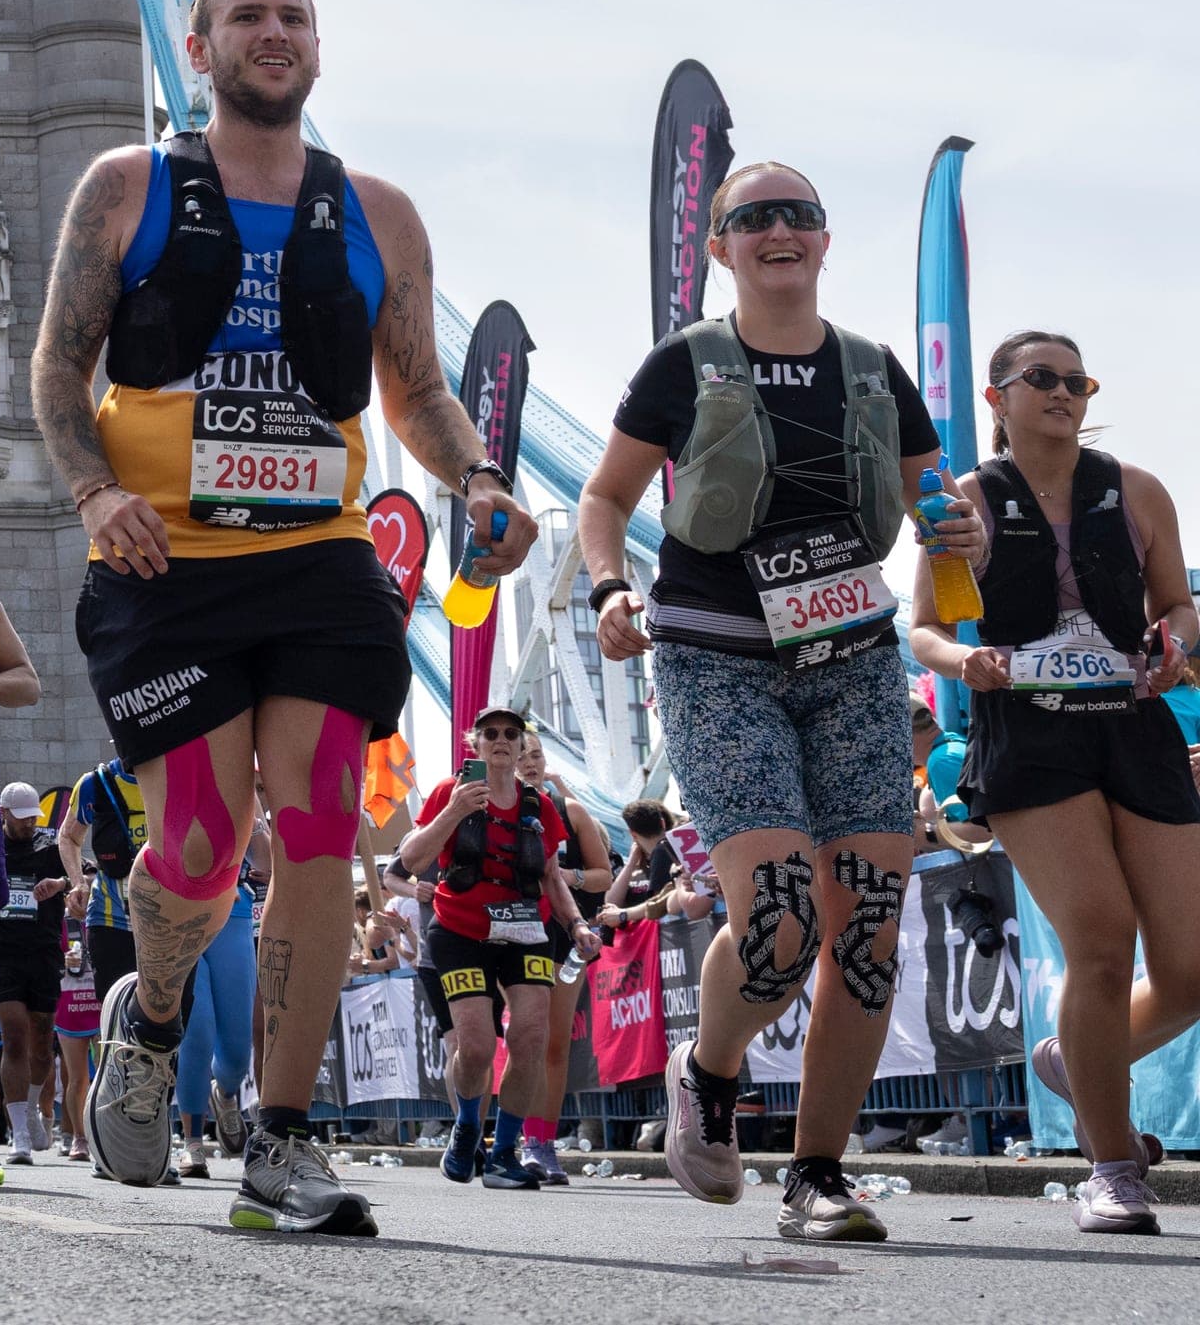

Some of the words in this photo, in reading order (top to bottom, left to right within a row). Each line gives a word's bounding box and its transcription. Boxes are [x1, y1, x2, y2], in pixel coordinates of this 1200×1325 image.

[178, 224, 224, 237] SALOMON
[679, 123, 708, 315] ACTION
[752, 363, 817, 388] LILY
[203, 398, 257, 433] tcs
[262, 400, 296, 412] TATA
[262, 424, 311, 437] SERVICES
[214, 453, 319, 492] 29831
[806, 533, 836, 548] TATA
[753, 548, 809, 582] tcs
[813, 552, 853, 570] SERVICES
[785, 578, 878, 629] 34692
[109, 665, 208, 721] GYMSHARK
[1063, 703, 1086, 712] new
[1087, 698, 1128, 711] balance
[138, 710, 163, 728] RUN
[161, 695, 191, 716] CLUB
[347, 1010, 374, 1082] tcs
